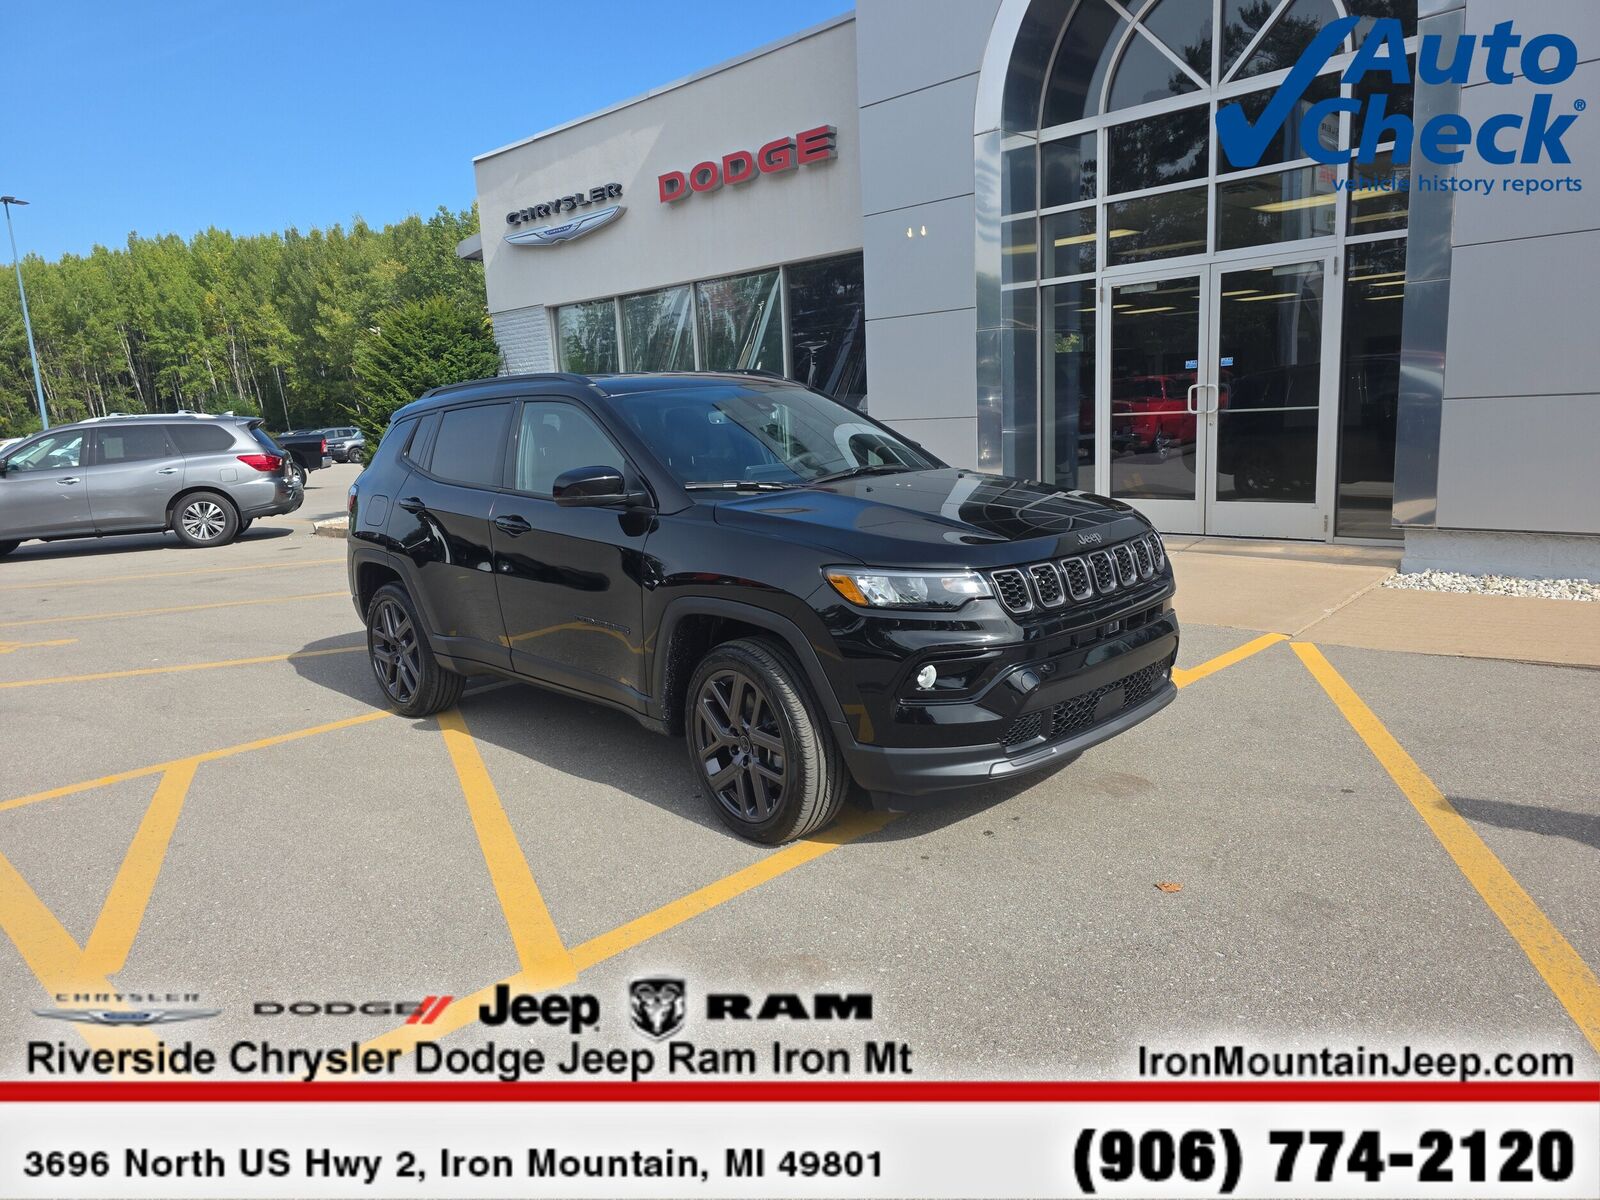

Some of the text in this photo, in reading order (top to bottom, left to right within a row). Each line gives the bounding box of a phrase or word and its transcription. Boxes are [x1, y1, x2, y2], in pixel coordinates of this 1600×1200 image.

[657, 124, 838, 204] DODGE
[505, 182, 623, 226] CHRYSLER
[1078, 532, 1102, 546] Jeep
